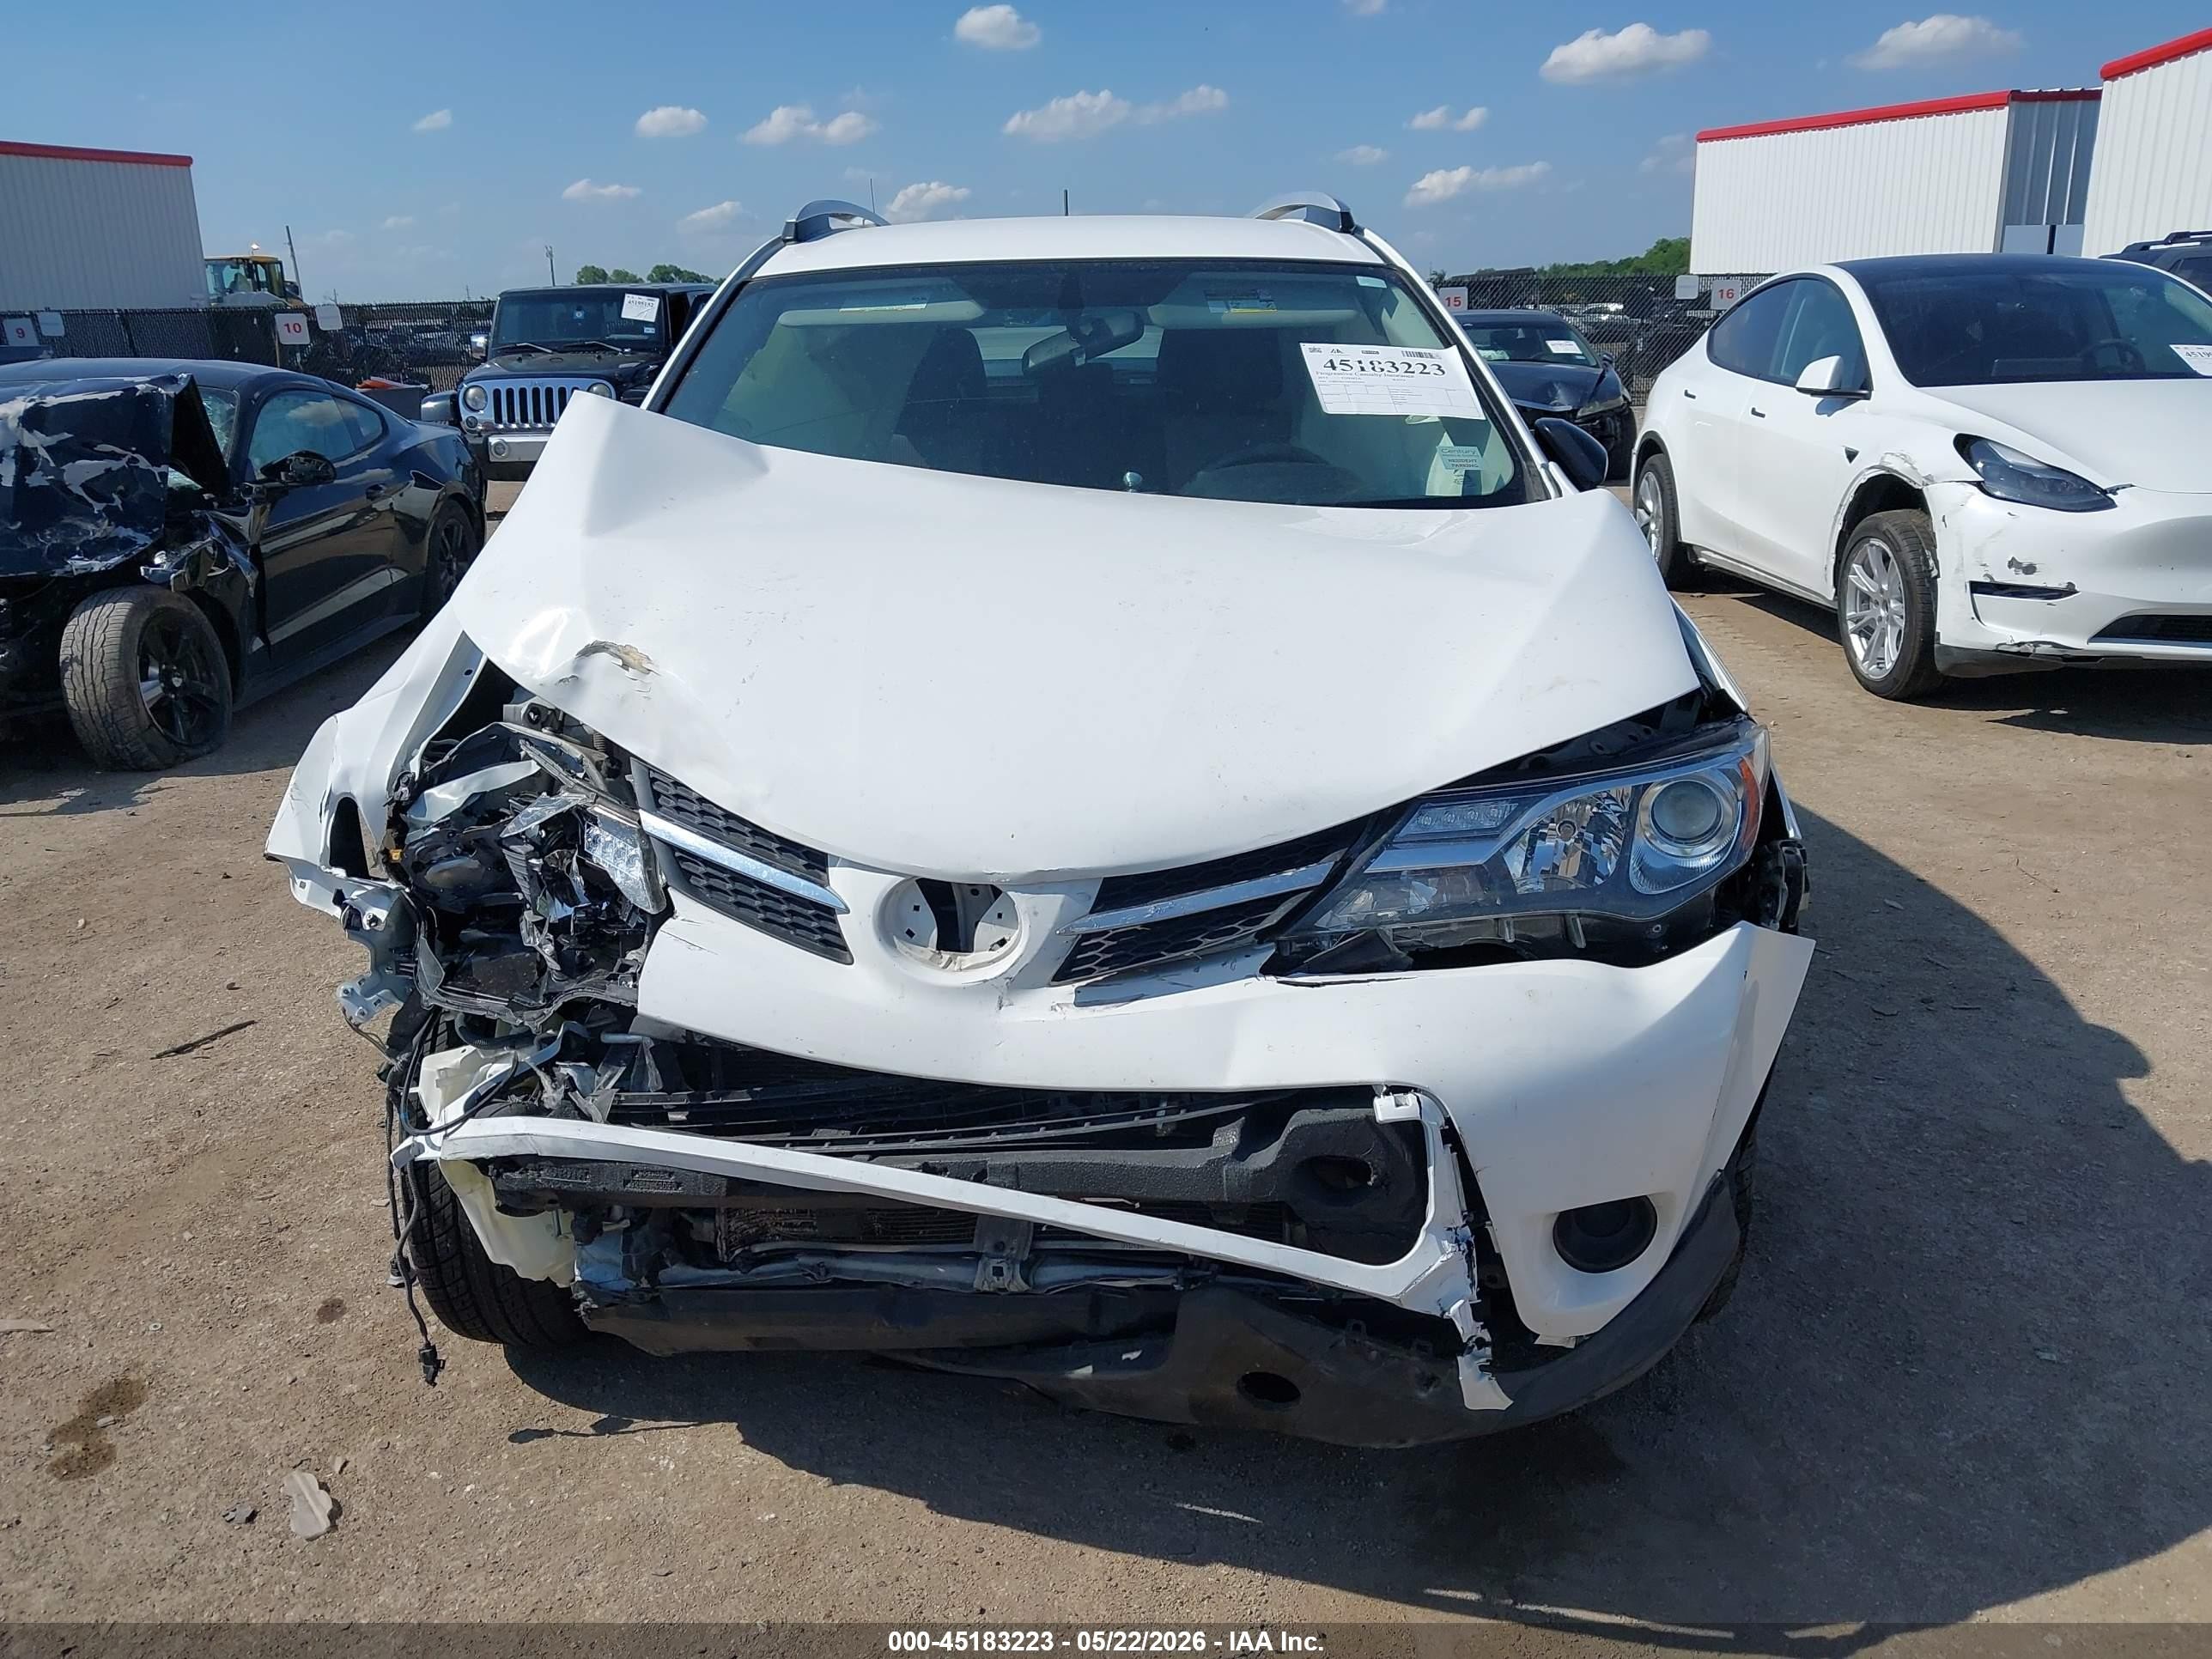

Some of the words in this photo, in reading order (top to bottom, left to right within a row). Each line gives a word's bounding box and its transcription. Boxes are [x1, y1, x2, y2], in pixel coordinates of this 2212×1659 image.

[1718, 289, 1735, 299] 16
[1444, 296, 1462, 307] 15
[15, 327, 25, 338] 9
[283, 322, 301, 333] 10
[1323, 358, 1446, 376] 45183223
